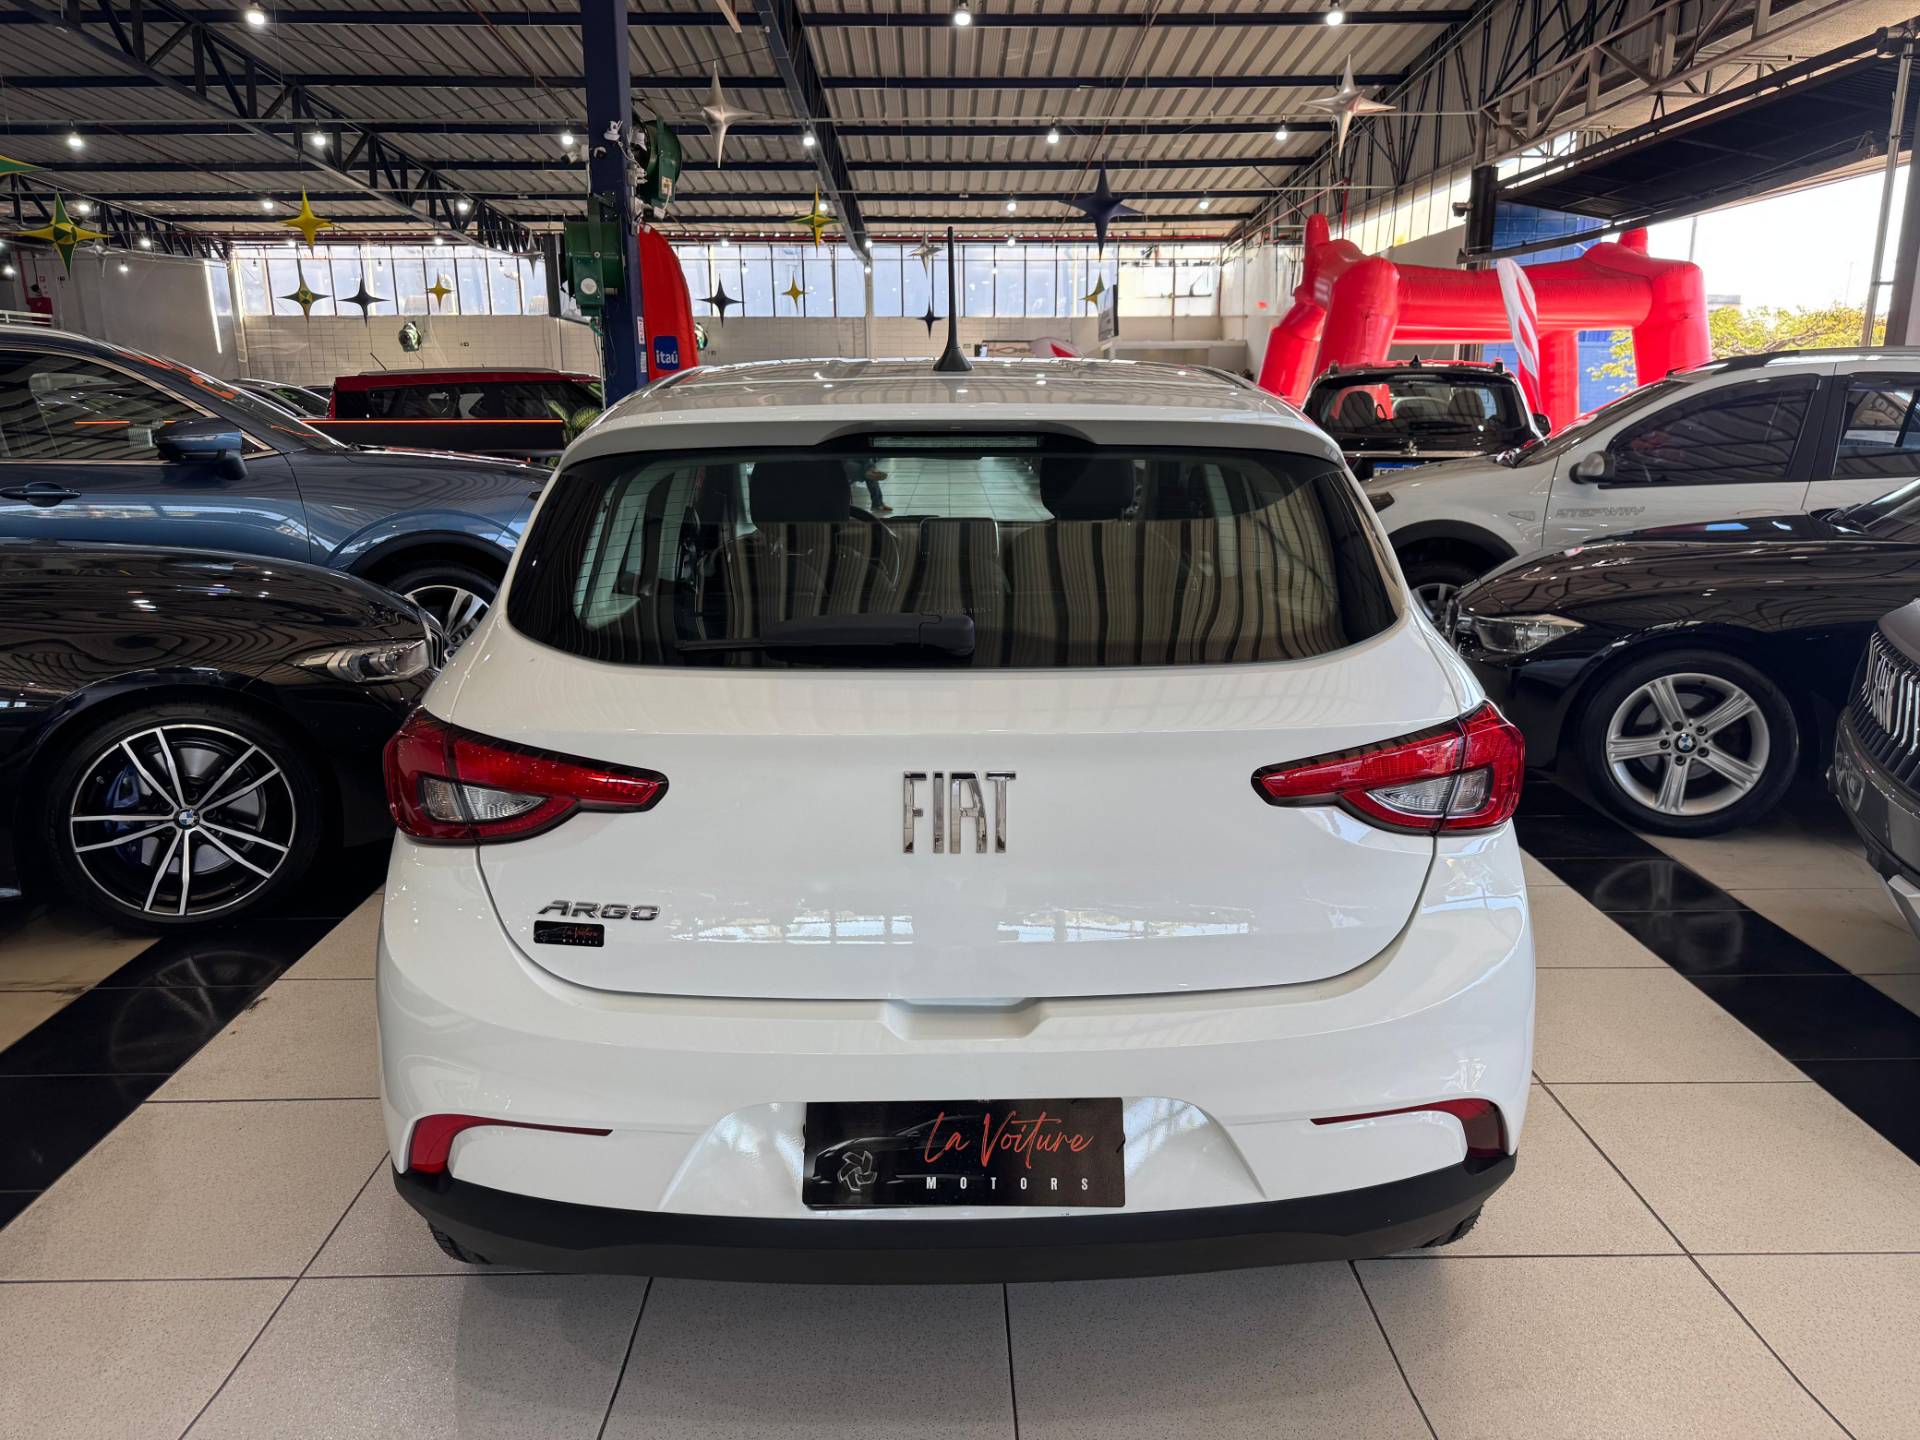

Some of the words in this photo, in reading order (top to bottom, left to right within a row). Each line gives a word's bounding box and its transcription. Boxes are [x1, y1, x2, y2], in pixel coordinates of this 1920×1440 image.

[656, 350, 679, 364] itaú
[903, 771, 1017, 854] FIAT
[537, 899, 660, 921] ARGO
[924, 1111, 971, 1163] La
[980, 1110, 1094, 1169] Voiture
[926, 1176, 1089, 1190] MOTORS
